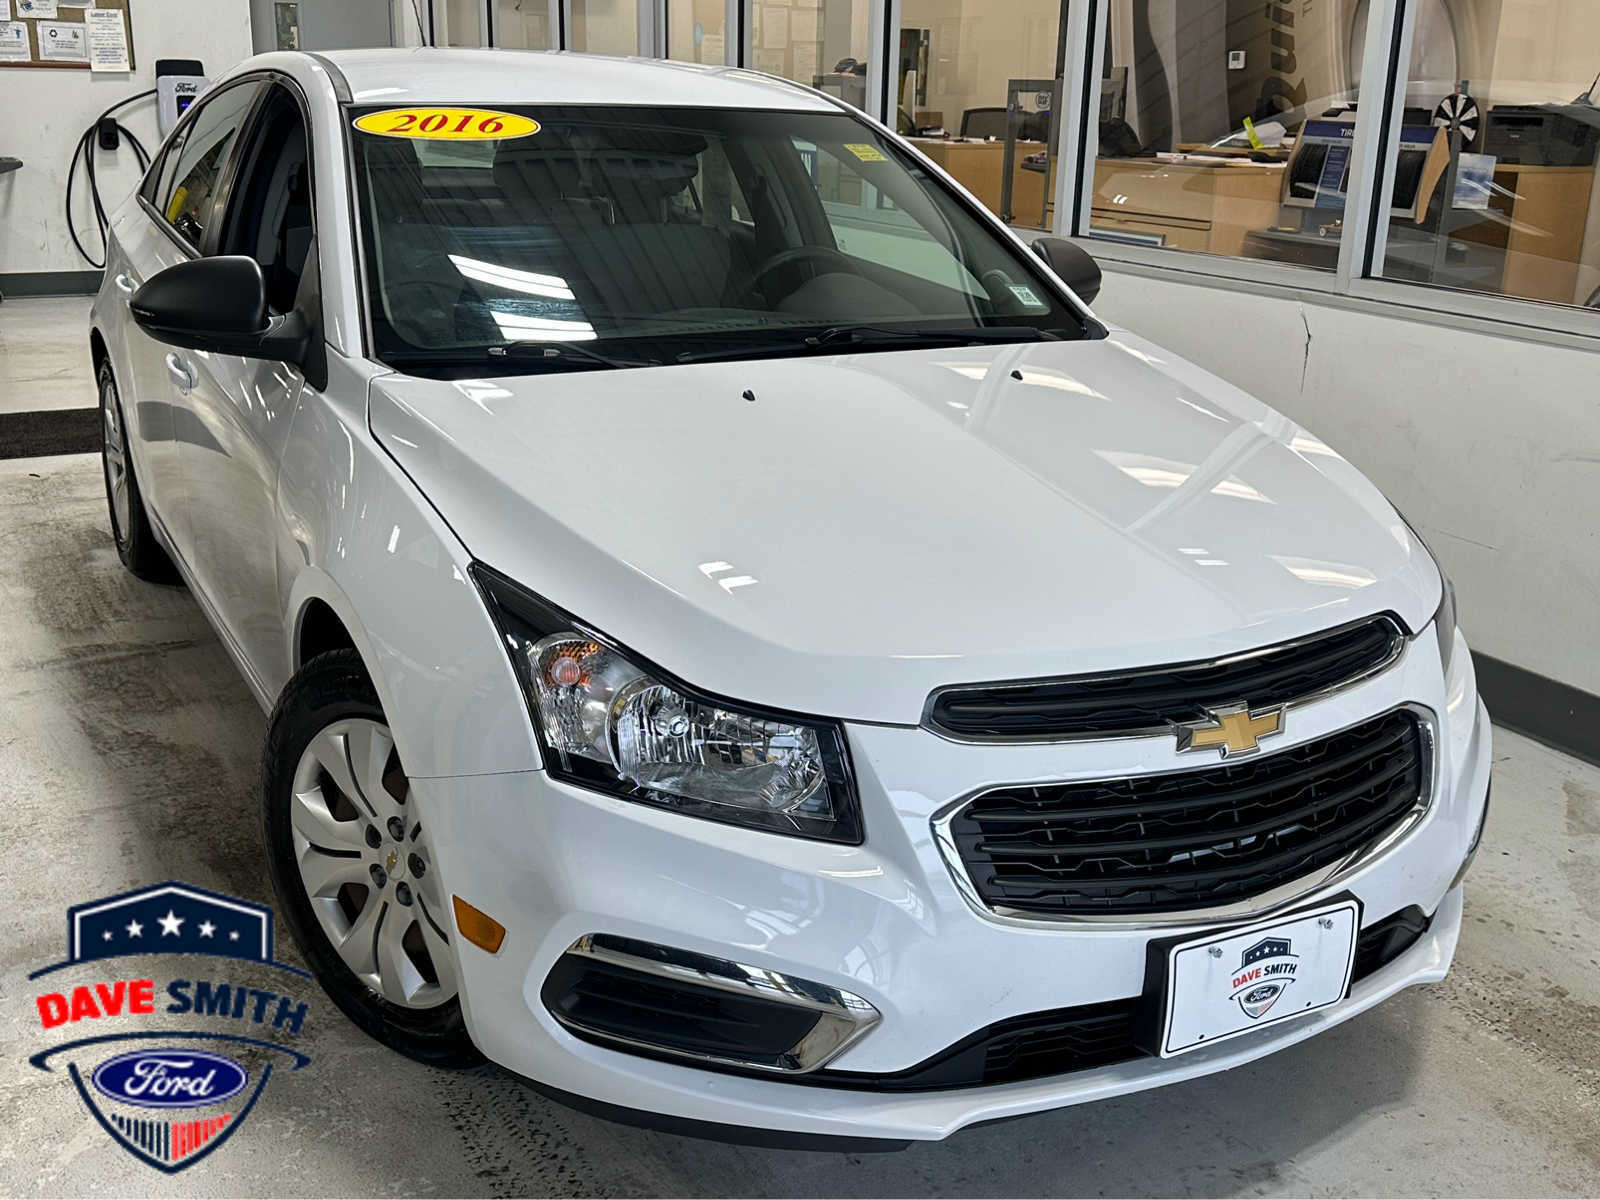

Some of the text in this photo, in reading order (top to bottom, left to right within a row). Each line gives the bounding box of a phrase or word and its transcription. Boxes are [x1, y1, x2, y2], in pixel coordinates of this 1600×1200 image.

[175, 82, 197, 92] Ford
[386, 114, 506, 133] 2016
[1340, 128, 1354, 137] TIR
[1232, 963, 1297, 988] DAVE SMITH
[1250, 986, 1273, 1001] Ford
